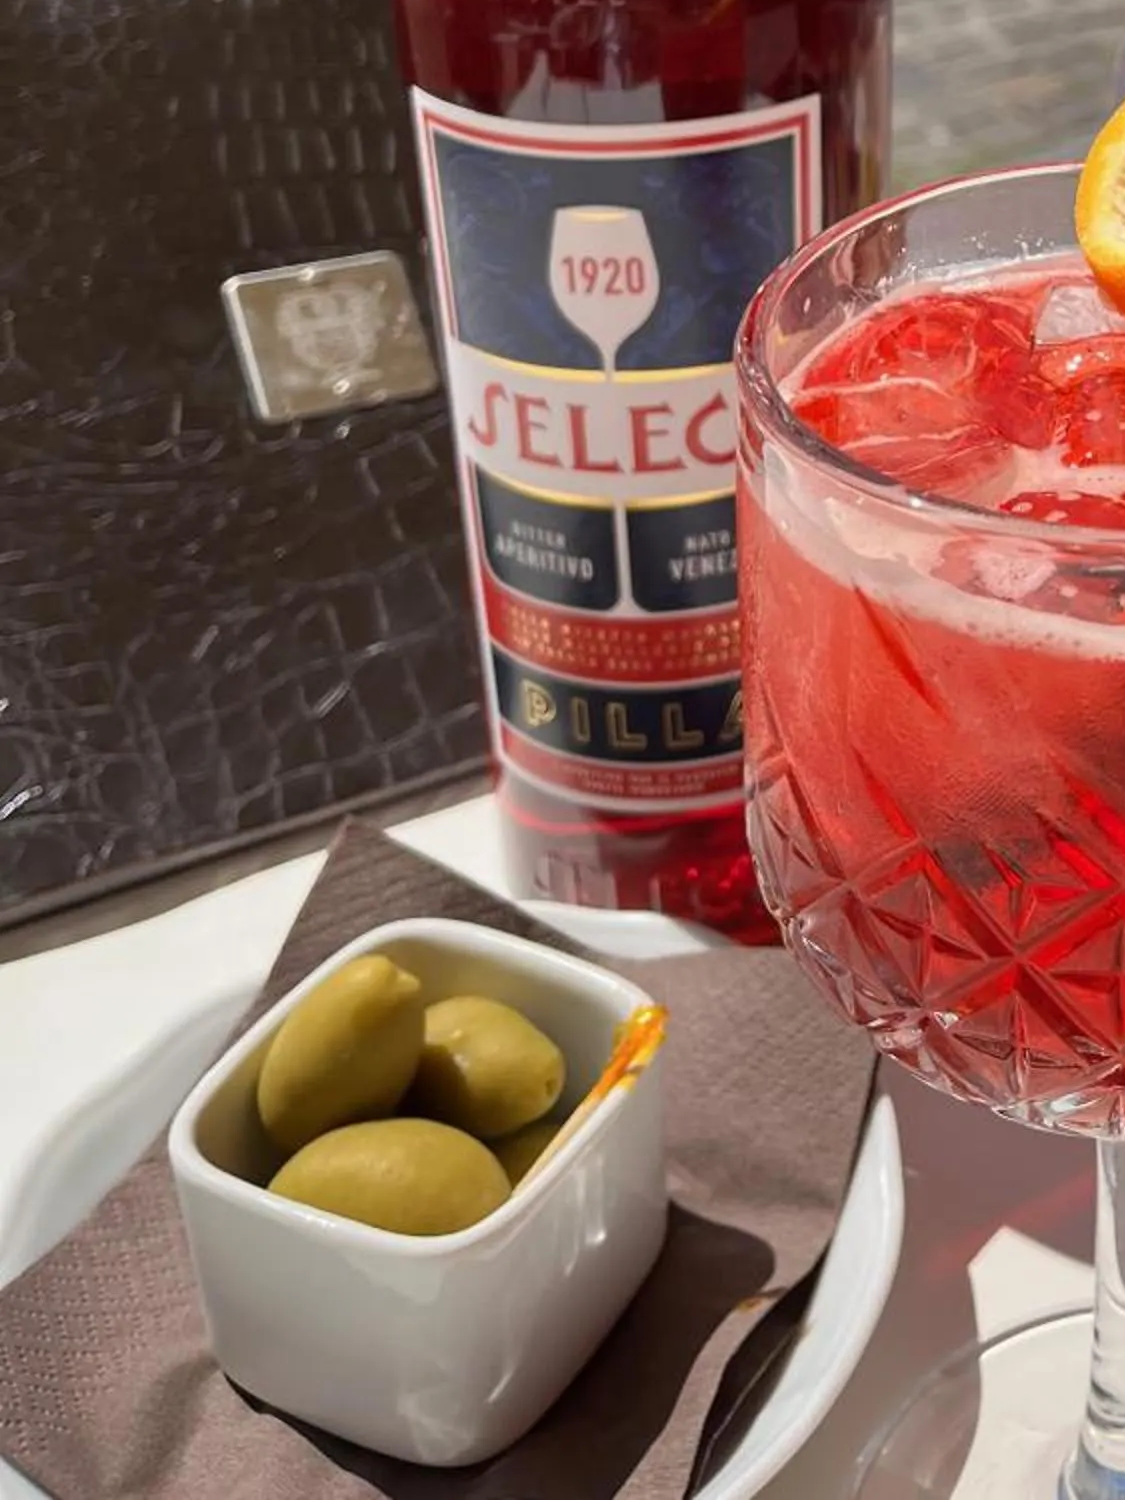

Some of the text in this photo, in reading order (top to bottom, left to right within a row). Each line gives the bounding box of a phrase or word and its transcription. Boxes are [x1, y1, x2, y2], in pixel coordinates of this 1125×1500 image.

[562, 256, 646, 296] 1920
[467, 382, 737, 473] SELEC
[495, 533, 594, 582] APERITIVO
